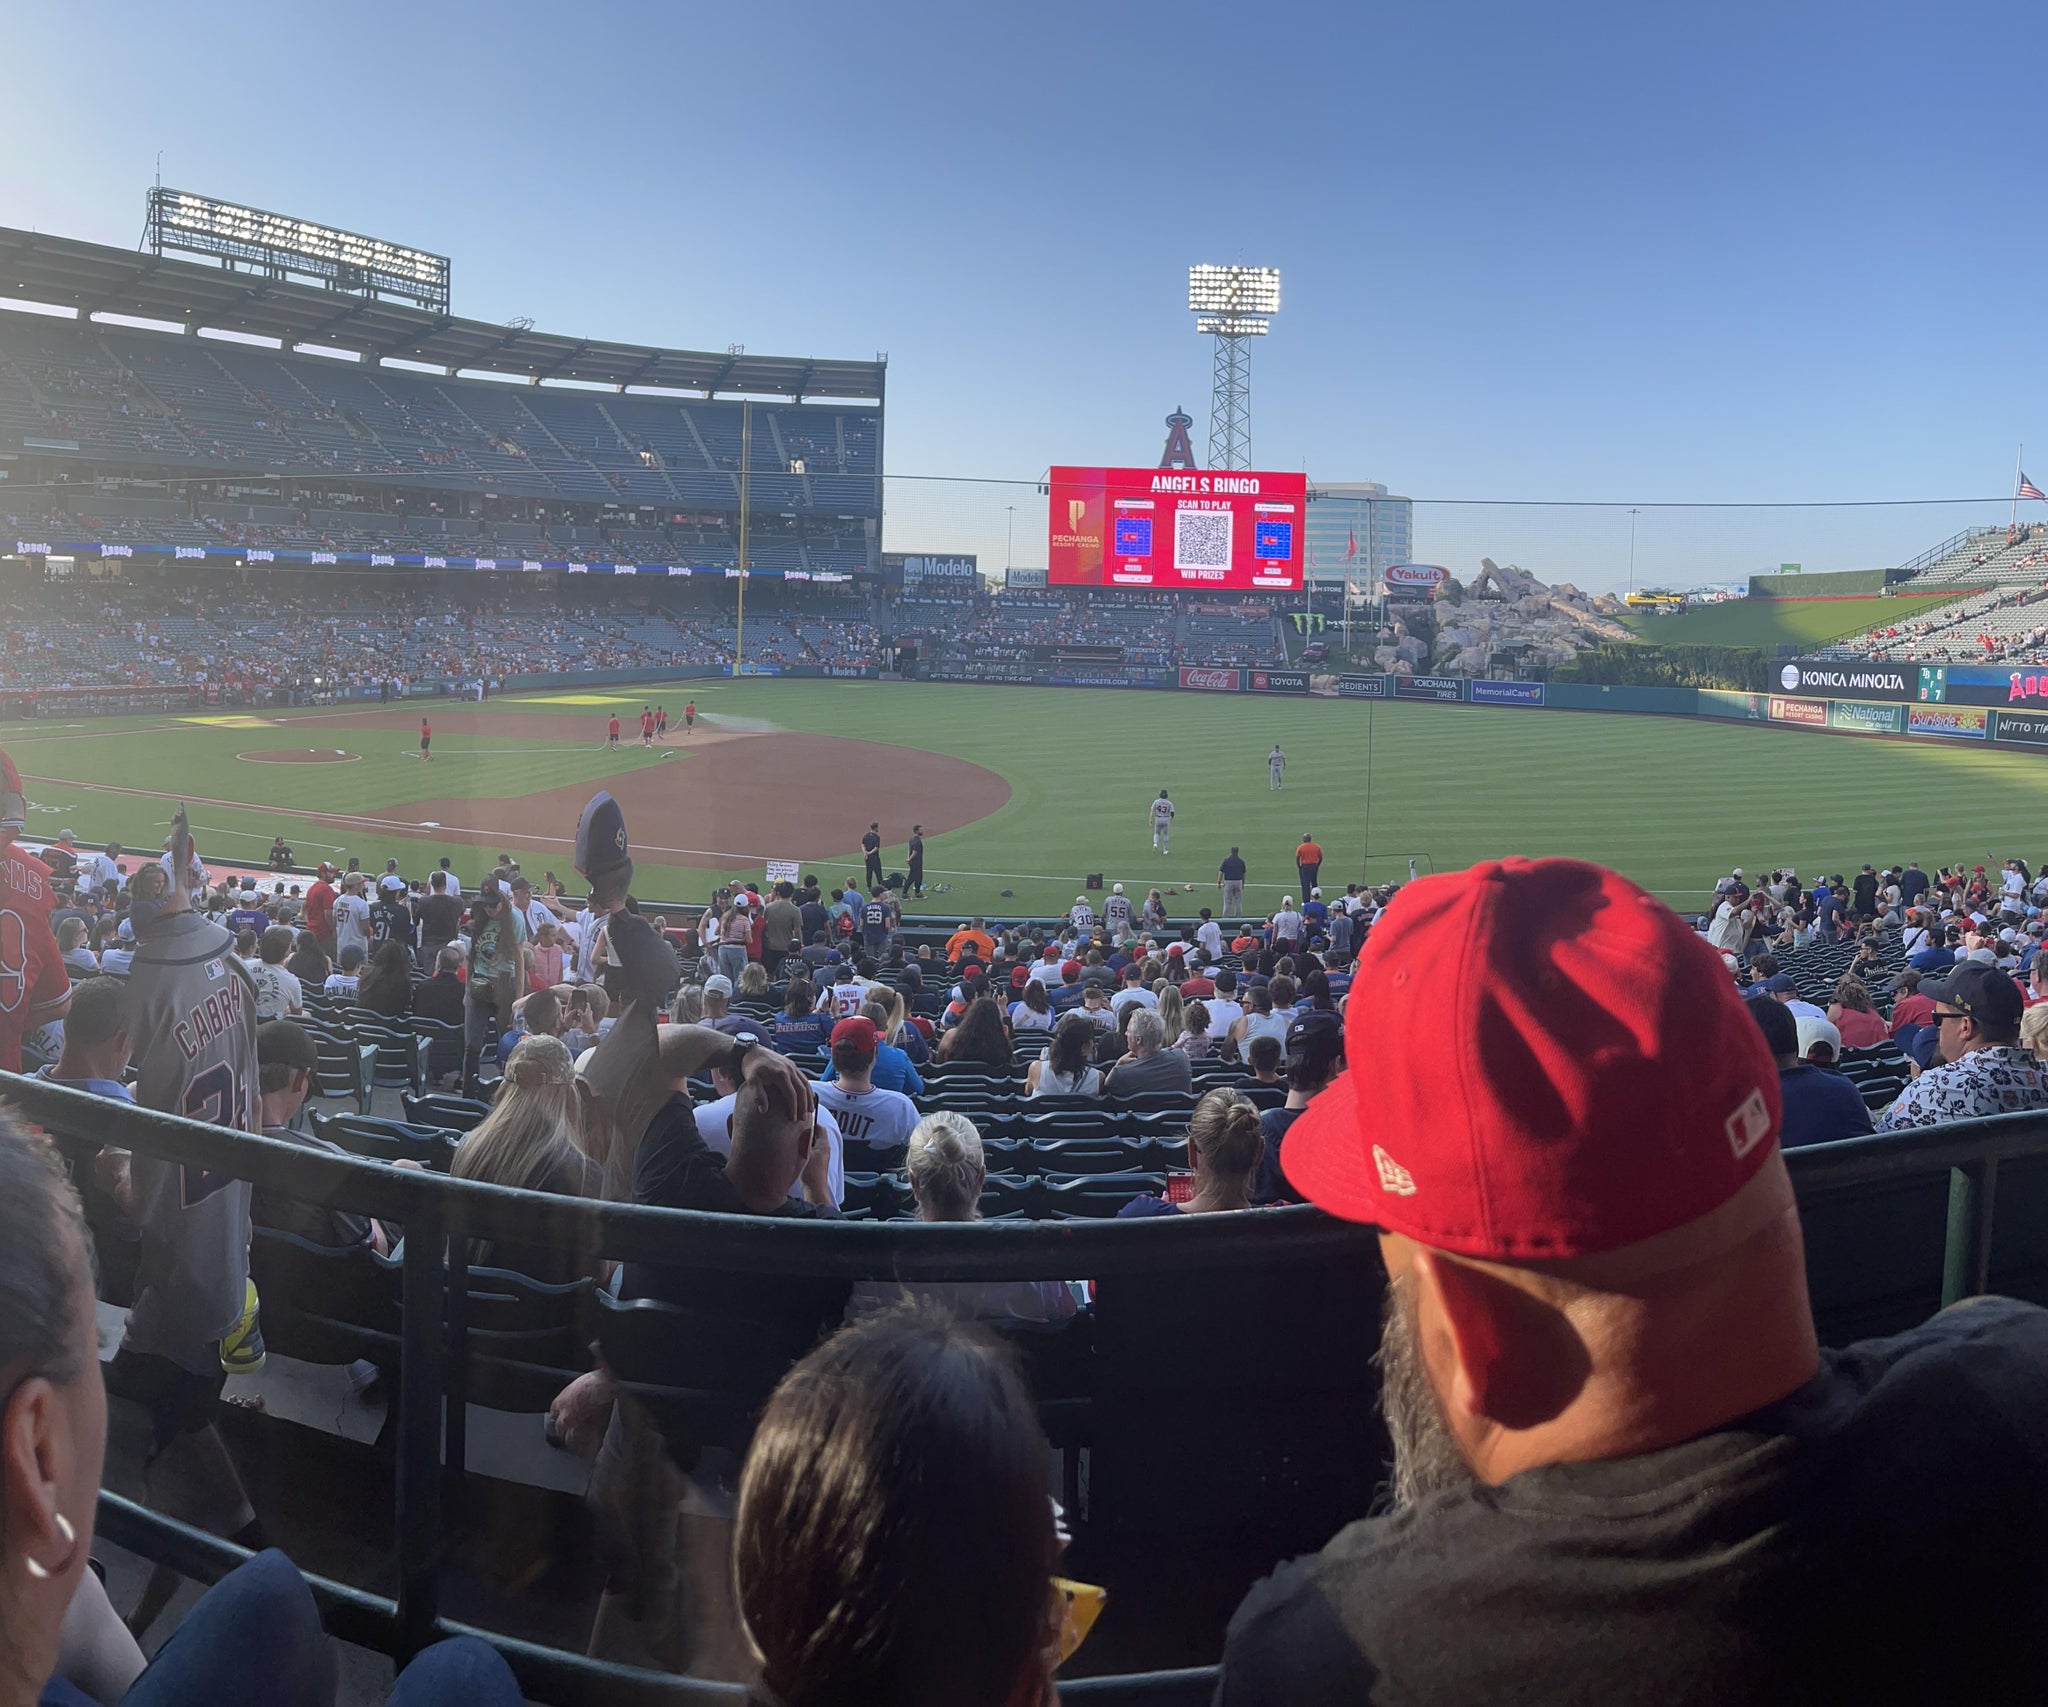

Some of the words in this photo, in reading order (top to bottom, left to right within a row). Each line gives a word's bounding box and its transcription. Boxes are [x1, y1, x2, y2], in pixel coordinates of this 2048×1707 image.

[1151, 475, 1210, 494] ANGELS
[1213, 477, 1260, 495] BINGO
[1177, 499, 1199, 510] SCAN
[1200, 500, 1211, 510] TO
[1211, 501, 1232, 511] PLAY
[1052, 534, 1100, 543] PECHANGA
[924, 556, 973, 577] Modelo
[1012, 570, 1042, 583] Modelo
[1180, 570, 1194, 580] WIN
[1195, 571, 1225, 581] PRIZES
[1397, 569, 1441, 582] Yakult
[832, 666, 857, 677] Modelo
[1269, 677, 1303, 687] TOYOTA
[1412, 678, 1457, 690] YOKOHAMA
[1802, 671, 1846, 687] KONICA
[1849, 673, 1905, 690] MINOLTA
[1436, 690, 1457, 699] TIRES
[1475, 686, 1530, 698] MemorialCare
[1935, 690, 1941, 700] 7
[1785, 703, 1823, 714] PECHANGA
[1851, 705, 1895, 722] National
[1912, 710, 1957, 729] Surfside
[1999, 719, 2031, 733] NITTO
[1156, 805, 1168, 814] 43
[337, 908, 350, 924] 27
[866, 910, 883, 924] 29
[1110, 906, 1126, 919] 55
[1077, 914, 1093, 926] 30
[374, 921, 391, 941] 31
